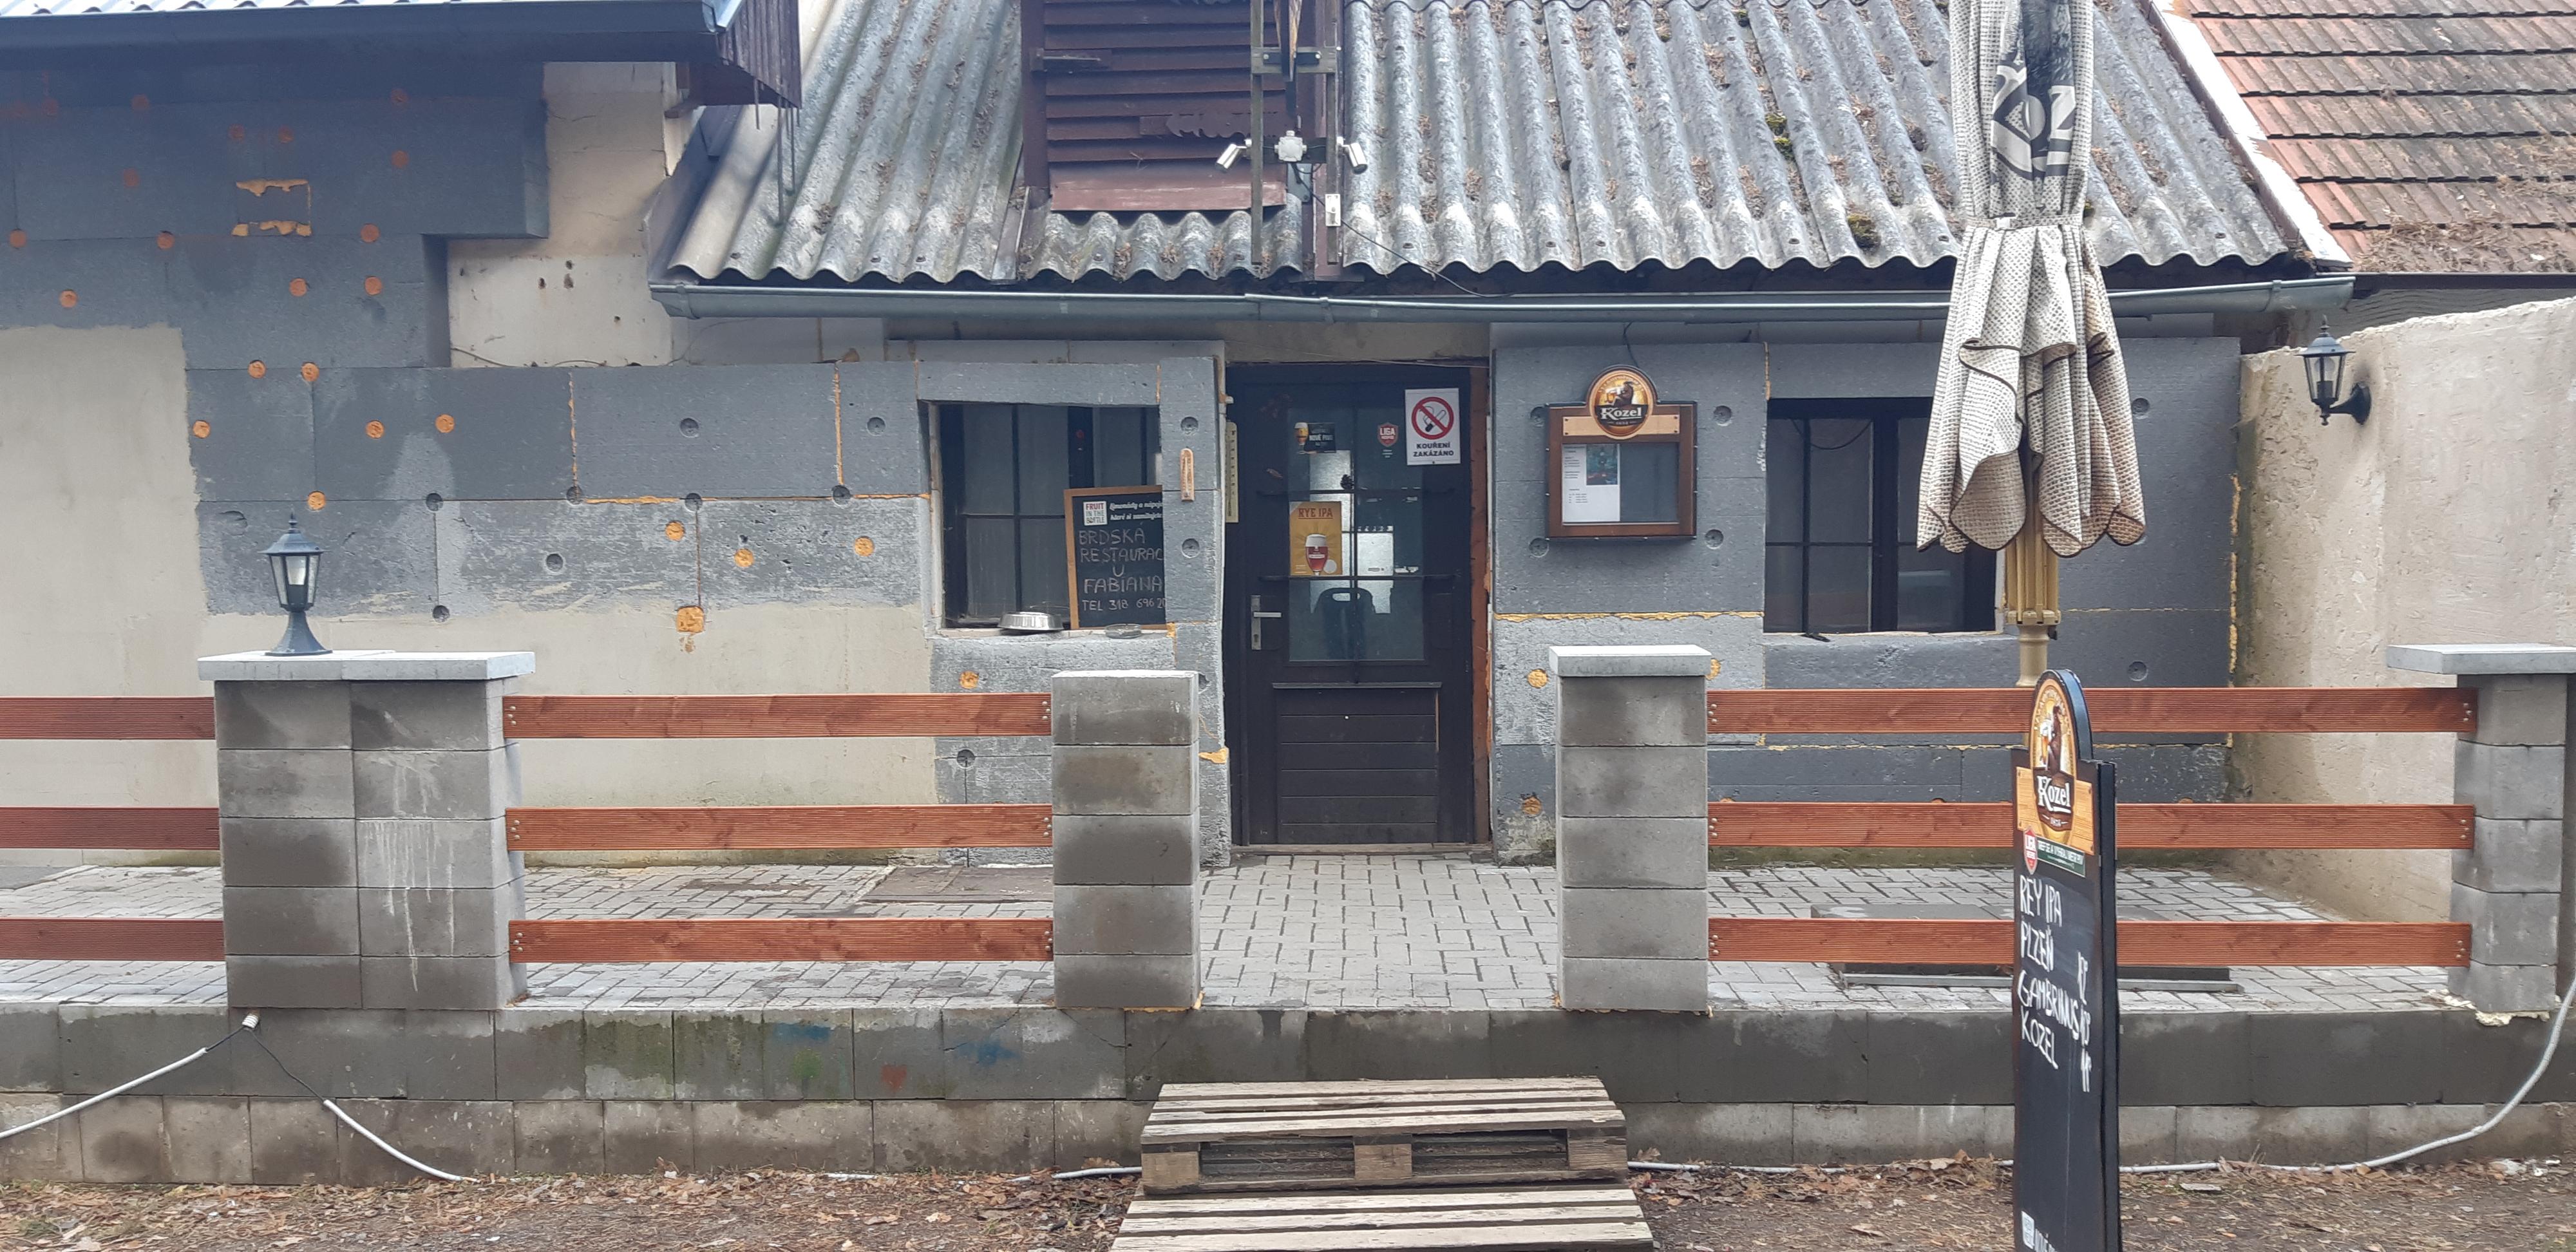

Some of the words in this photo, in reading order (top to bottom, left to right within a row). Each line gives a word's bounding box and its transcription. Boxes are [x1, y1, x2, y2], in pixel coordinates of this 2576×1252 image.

[1600, 407, 1642, 421] Kozel
[1298, 507, 1316, 517] RYE
[1318, 507, 1333, 517] IPA
[1079, 521, 1145, 545] BRDSKÁ
[1112, 564, 1124, 576] U
[1084, 575, 1163, 593] FABIANA
[1082, 600, 1103, 611] TEL
[1108, 599, 1128, 610] 318
[2036, 775, 2072, 813] Kozel
[2020, 875, 2042, 916] REY
[2045, 884, 2062, 927] IPA
[2018, 969, 2079, 1041] GAMBRINUS
[2021, 1005, 2059, 1070] KOZEL
